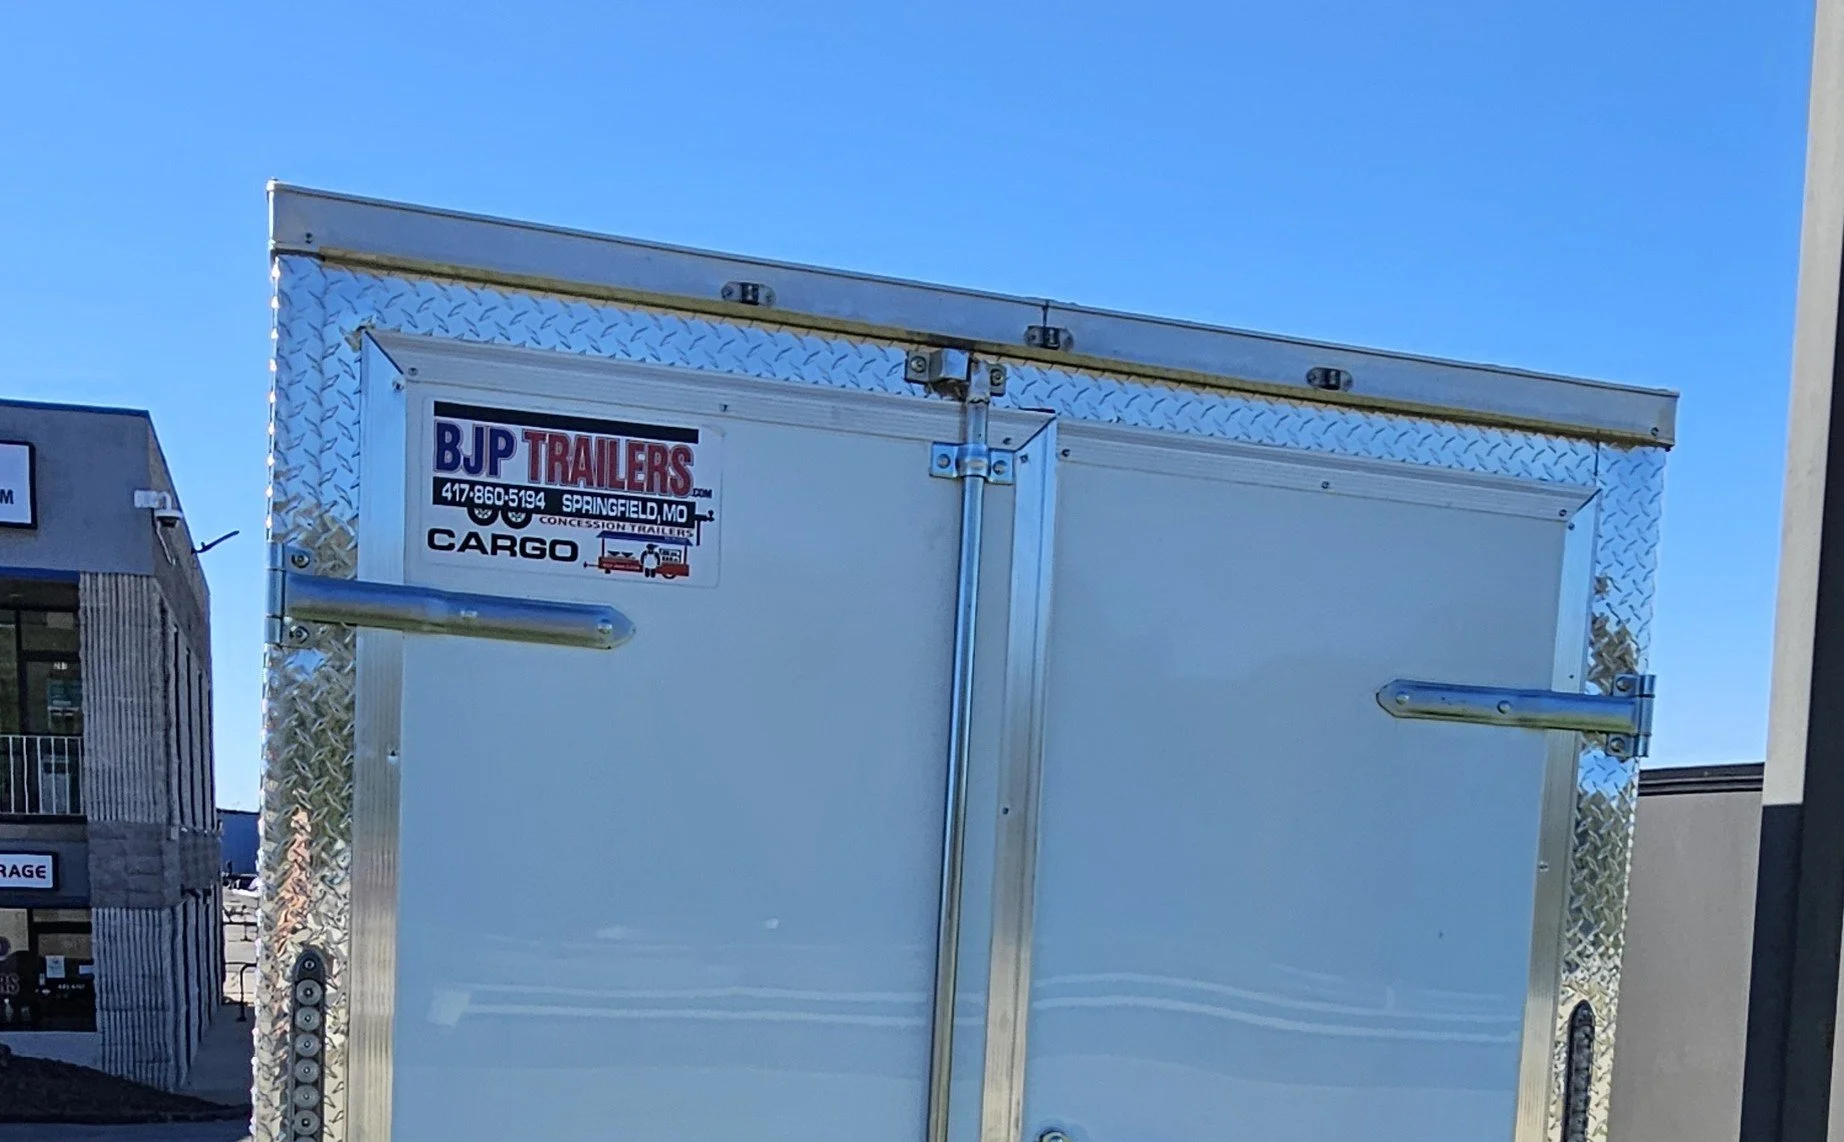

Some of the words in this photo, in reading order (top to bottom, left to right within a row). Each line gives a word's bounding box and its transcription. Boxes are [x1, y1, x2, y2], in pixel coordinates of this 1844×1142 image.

[433, 419, 518, 478] BJP
[522, 428, 695, 499] TRAILERS
[539, 516, 627, 531] CONCESSION
[629, 523, 694, 537] TRAILERS
[427, 528, 579, 562] CARGO
